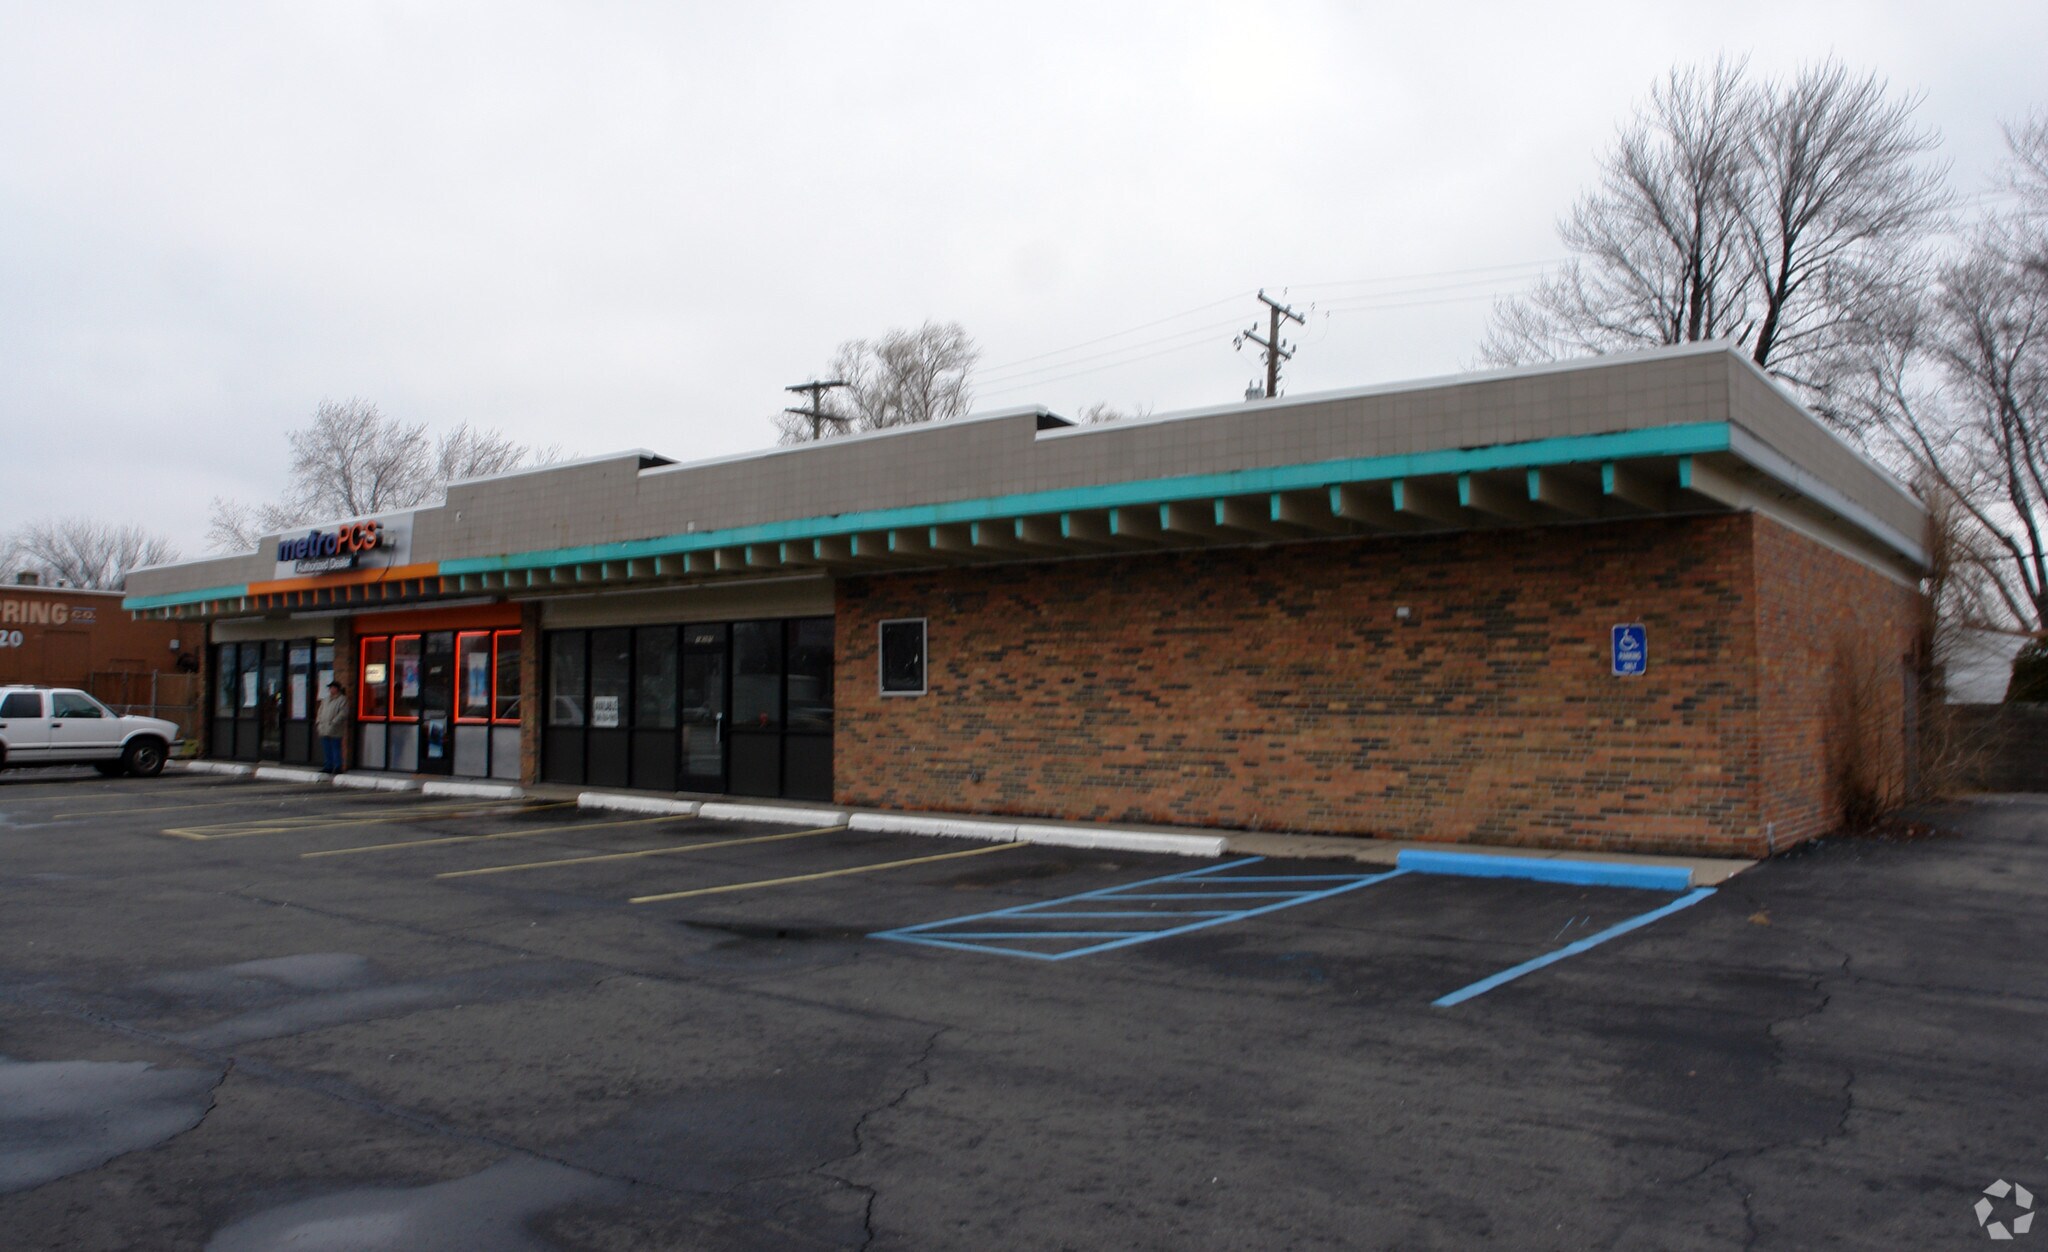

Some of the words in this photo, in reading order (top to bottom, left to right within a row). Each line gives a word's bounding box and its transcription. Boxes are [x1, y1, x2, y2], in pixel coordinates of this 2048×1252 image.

[277, 521, 382, 561] metroPCS
[330, 556, 350, 569] Dealer
[0, 600, 68, 624] RING
